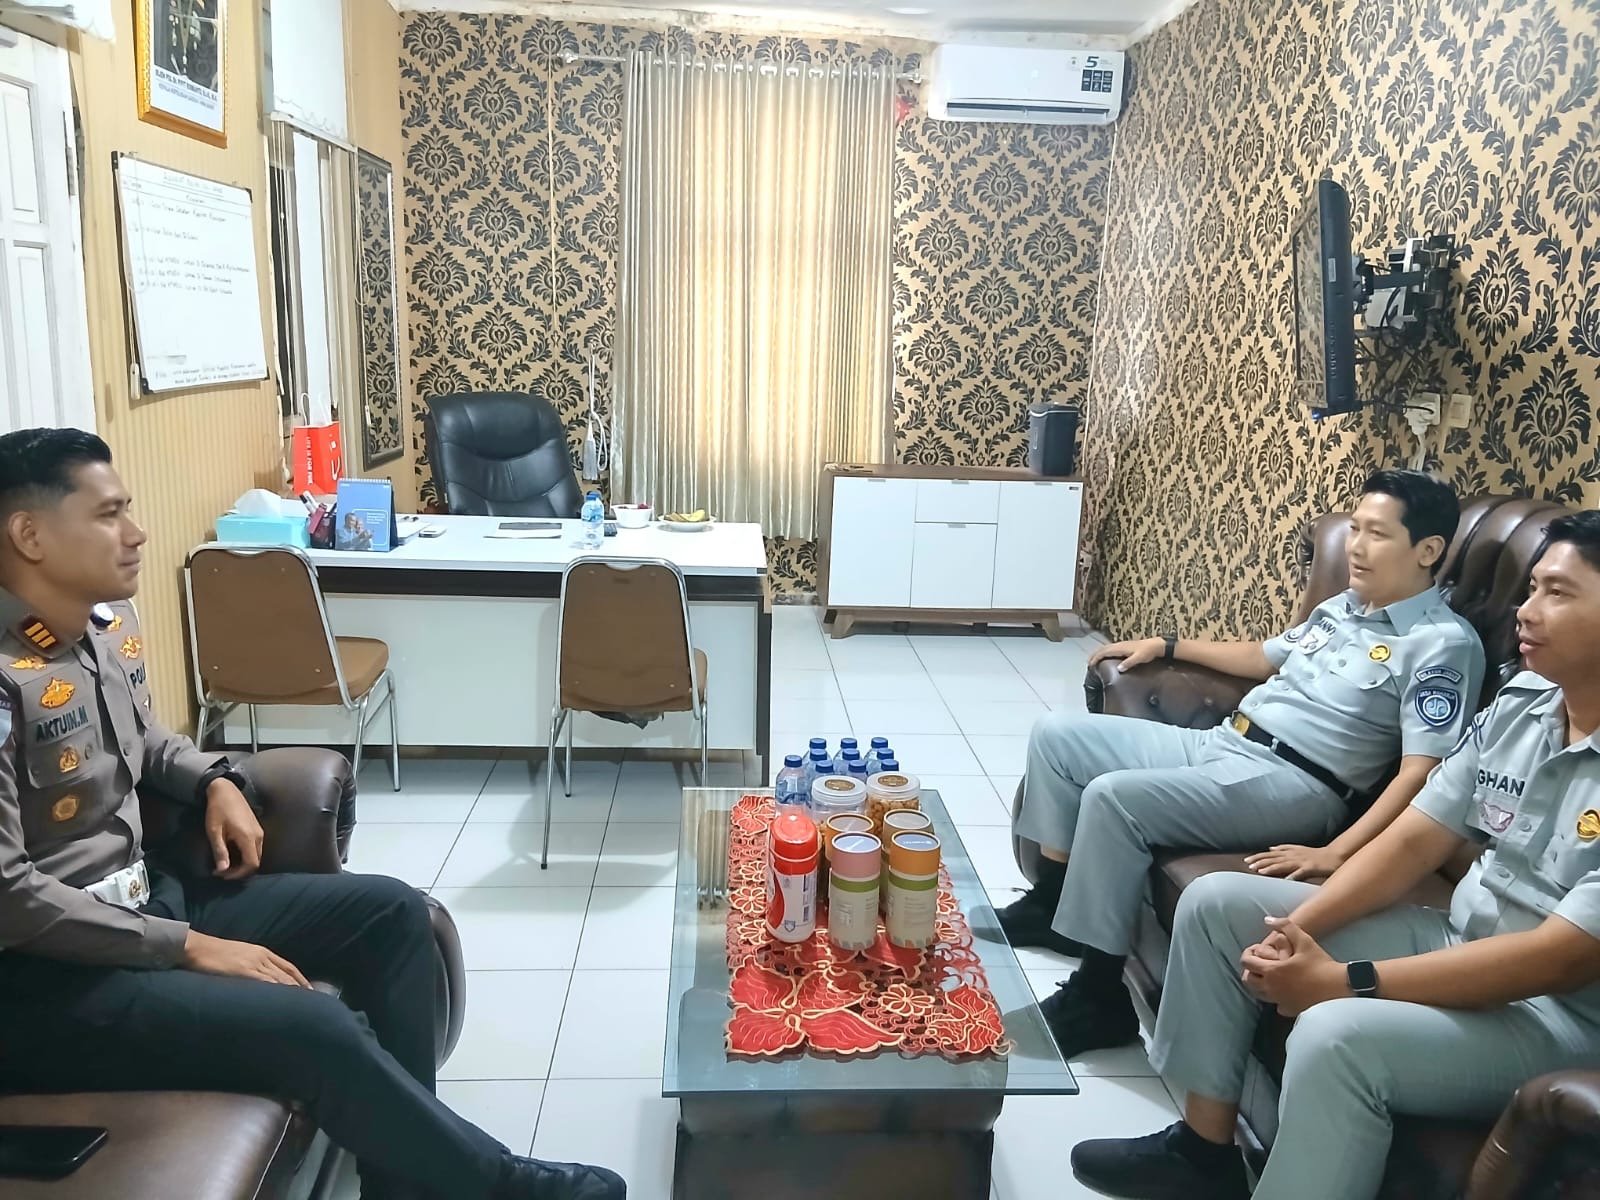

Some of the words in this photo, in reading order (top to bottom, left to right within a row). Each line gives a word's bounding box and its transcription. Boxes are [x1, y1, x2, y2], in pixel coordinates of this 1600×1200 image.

[1085, 56, 1099, 68] 5
[36, 704, 89, 742] AKTUIN.M
[1478, 769, 1526, 797] GHAN
